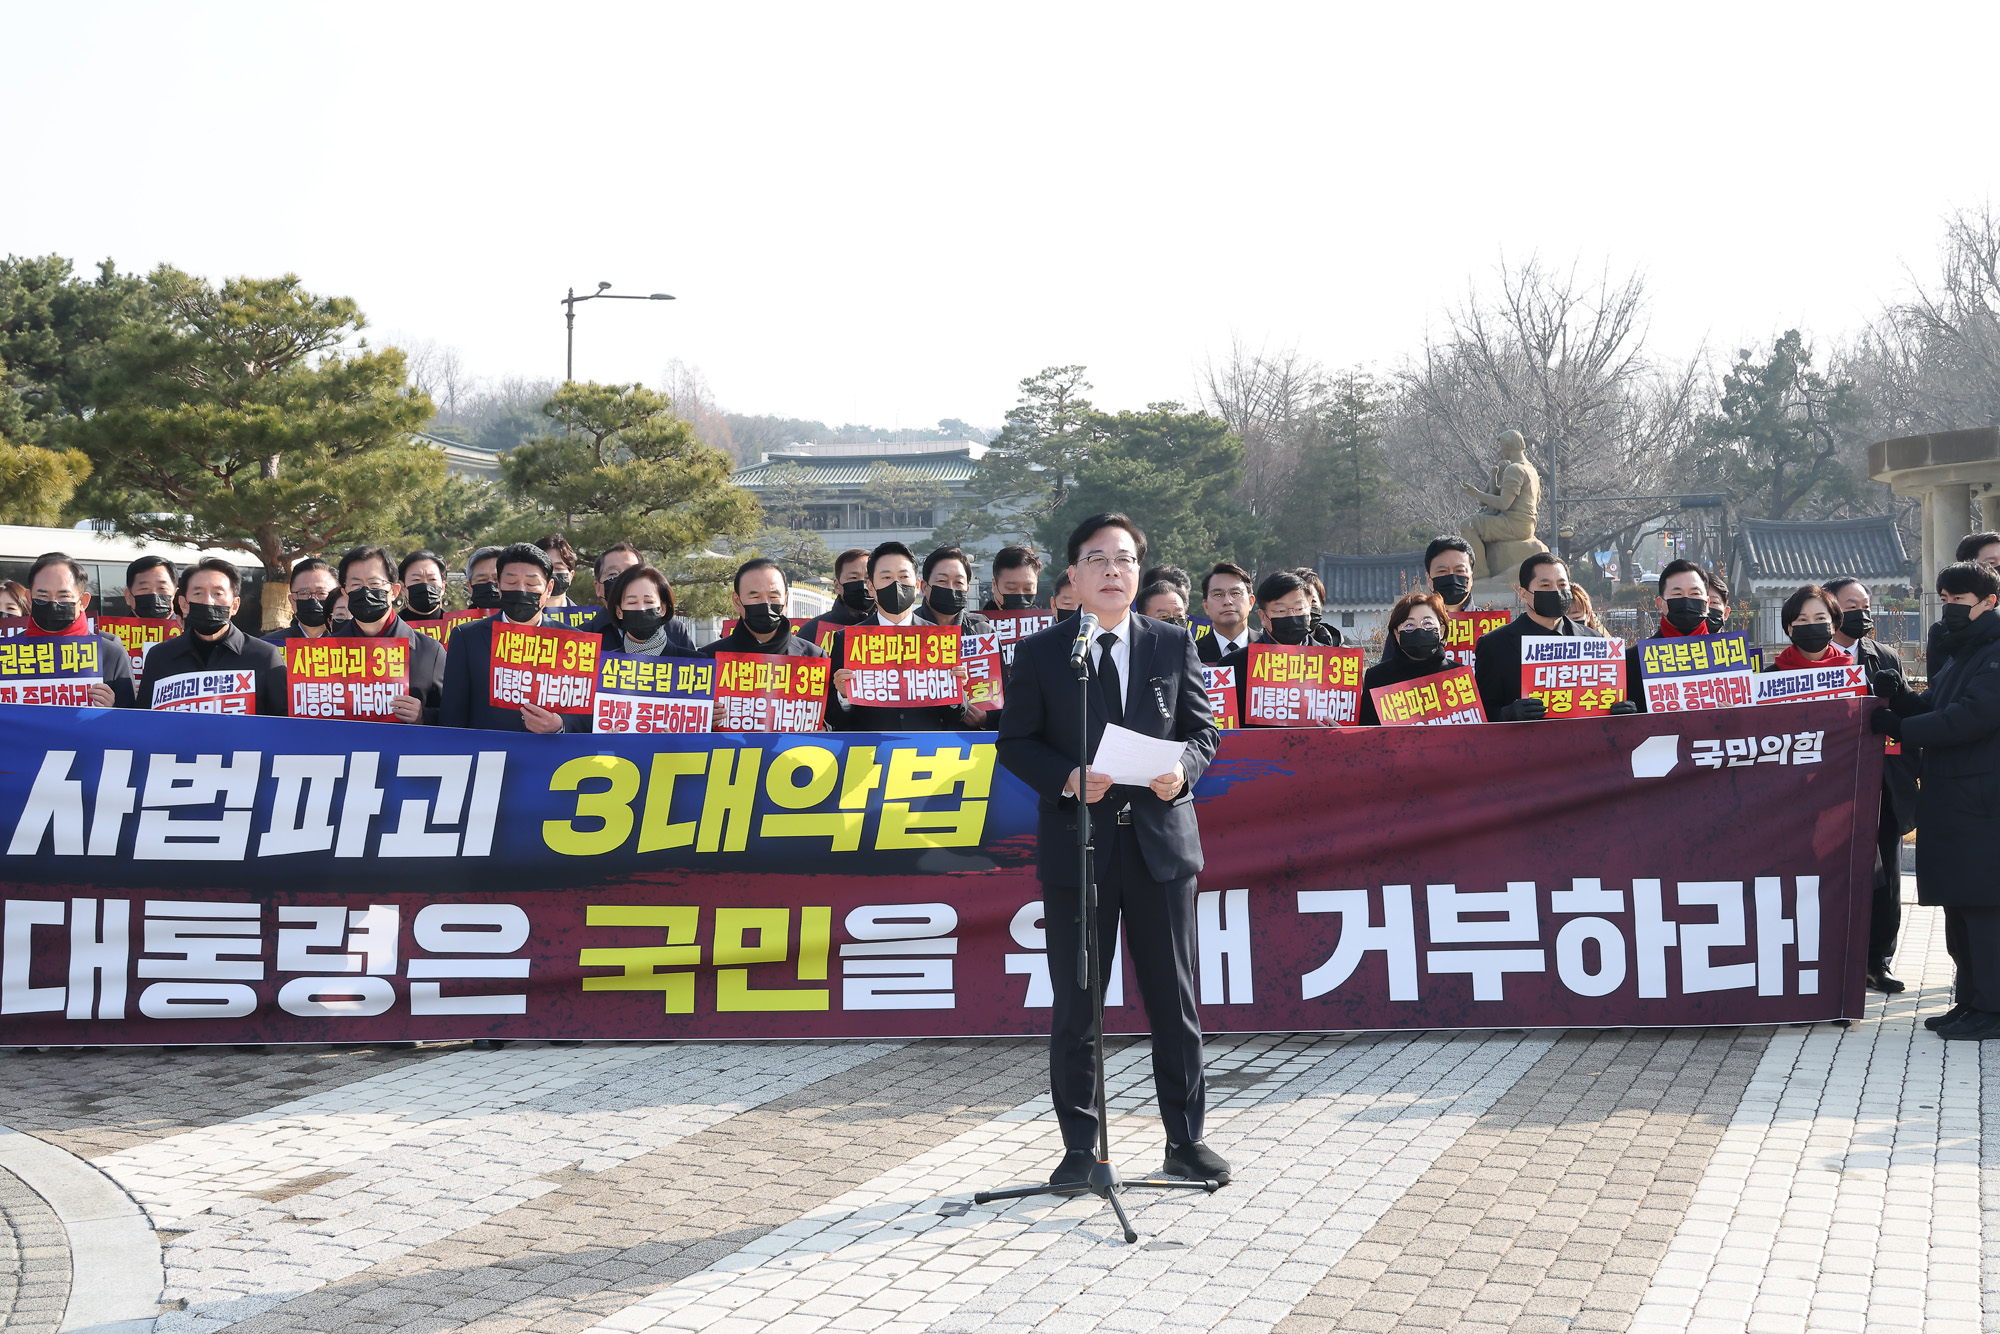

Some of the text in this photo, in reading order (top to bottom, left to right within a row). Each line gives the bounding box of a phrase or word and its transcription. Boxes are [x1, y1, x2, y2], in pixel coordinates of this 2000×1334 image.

[60, 641, 98, 673] 파괴
[292, 645, 366, 678] 사법파괴
[372, 646, 405, 678] 3법
[494, 630, 559, 669] 사법파괴
[562, 639, 597, 673] 3법
[849, 633, 920, 665] 사법파괴
[926, 633, 957, 664] 3법
[1525, 641, 1608, 661] 사법파괴 악법
[1643, 640, 1710, 674] 삼권분립
[1711, 636, 1748, 667] 파괴
[493, 666, 592, 708] 대통령은 거부하라!
[601, 658, 713, 696] 삼권분립 파괴
[718, 660, 826, 697] 사법파괴 3법
[850, 669, 901, 702] 대통령은
[902, 669, 959, 701] 거부하라!
[1252, 651, 1359, 687] 사법파괴 3법
[1534, 663, 1618, 689] 대한민국
[1758, 673, 1814, 698] 사법파괴
[1816, 669, 1844, 688] 악법
[154, 674, 234, 705] 사법파괴 악법
[293, 682, 345, 717] 대통령은
[1250, 686, 1301, 721] 대통령은
[1303, 688, 1357, 722] 거부하라!
[1379, 682, 1442, 723] 사법파괴
[1442, 673, 1477, 707] 3법
[1648, 682, 1680, 713] 당장
[1683, 675, 1752, 710] 중단하라!
[598, 699, 709, 733] 당장 중단하라!
[770, 698, 823, 732] 거부하라!
[1690, 730, 1825, 770] 국민의힘
[6, 742, 998, 861] 사법파괴 3대악법
[1, 897, 532, 1020] 대통령은
[578, 902, 959, 1014] 국민을
[1296, 875, 1821, 1002] 거부하라!
